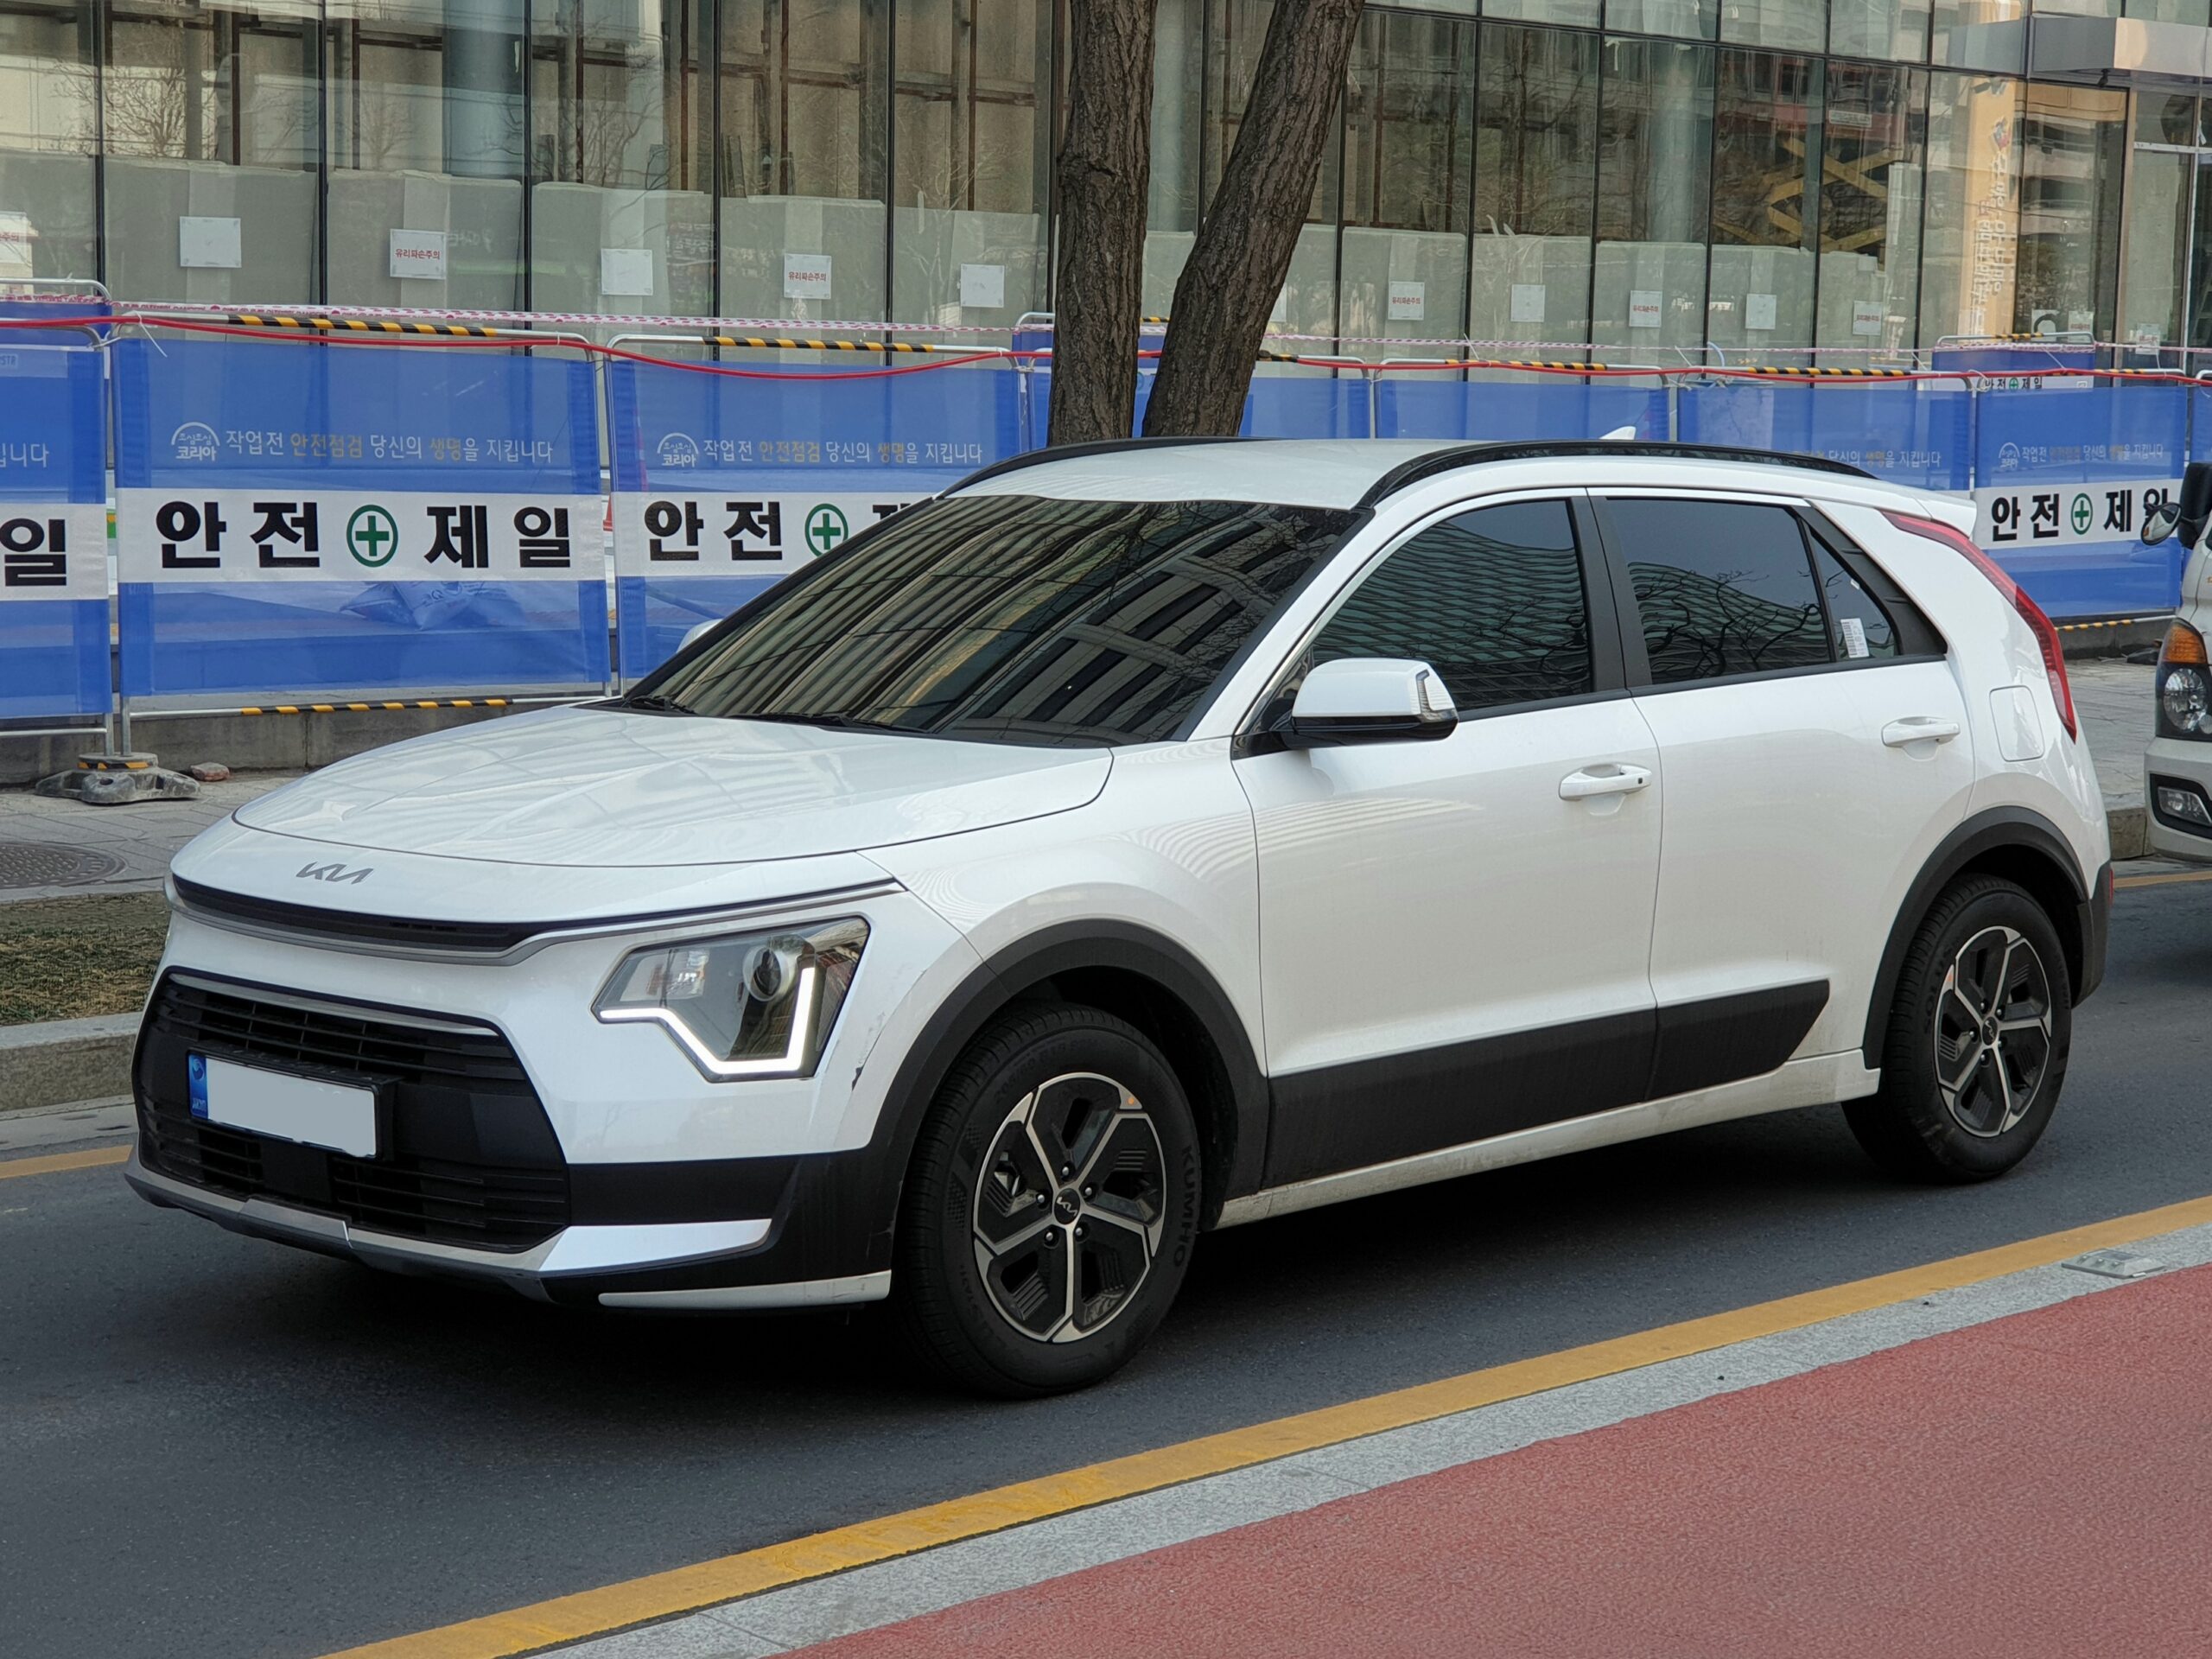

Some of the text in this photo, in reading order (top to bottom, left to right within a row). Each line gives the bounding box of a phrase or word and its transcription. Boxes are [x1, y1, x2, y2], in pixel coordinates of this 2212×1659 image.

[395, 249, 440, 260] 유리파손주의
[788, 271, 827, 282] 유리파손주의
[175, 446, 217, 461] 코리아
[226, 430, 553, 463] 작업전 안전점검 당신의 생명을 지킵니다
[703, 440, 982, 464] 작업전 안전점검 당신의 생명을 지킵니다
[662, 454, 696, 467] 코리아
[1900, 450, 1942, 468] 지킵니다
[1991, 493, 2060, 542] 안전
[645, 501, 782, 561] 안전
[296, 861, 374, 885] KIA
[1173, 1145, 1196, 1268] KUMHO
